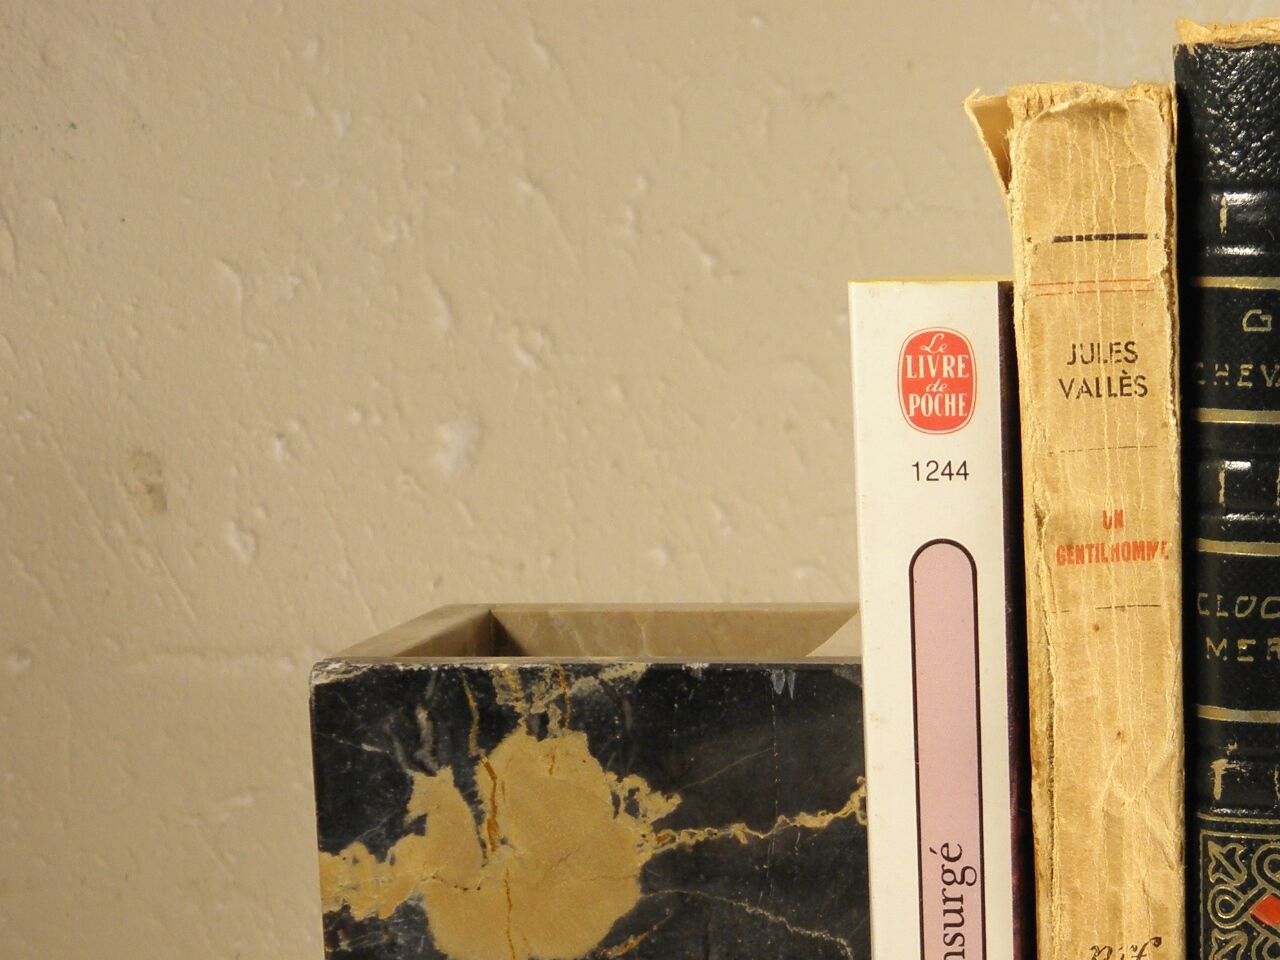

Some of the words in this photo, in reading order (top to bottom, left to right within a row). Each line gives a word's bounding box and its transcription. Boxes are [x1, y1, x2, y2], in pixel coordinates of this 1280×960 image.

[919, 333, 948, 353] Le
[1066, 340, 1138, 365] JULES
[905, 354, 970, 379] LIVRE
[925, 378, 948, 393] de
[1058, 369, 1148, 399] VALLÈS
[908, 392, 968, 417] POCHE
[911, 459, 970, 482] 1244
[1102, 509, 1124, 530] UN
